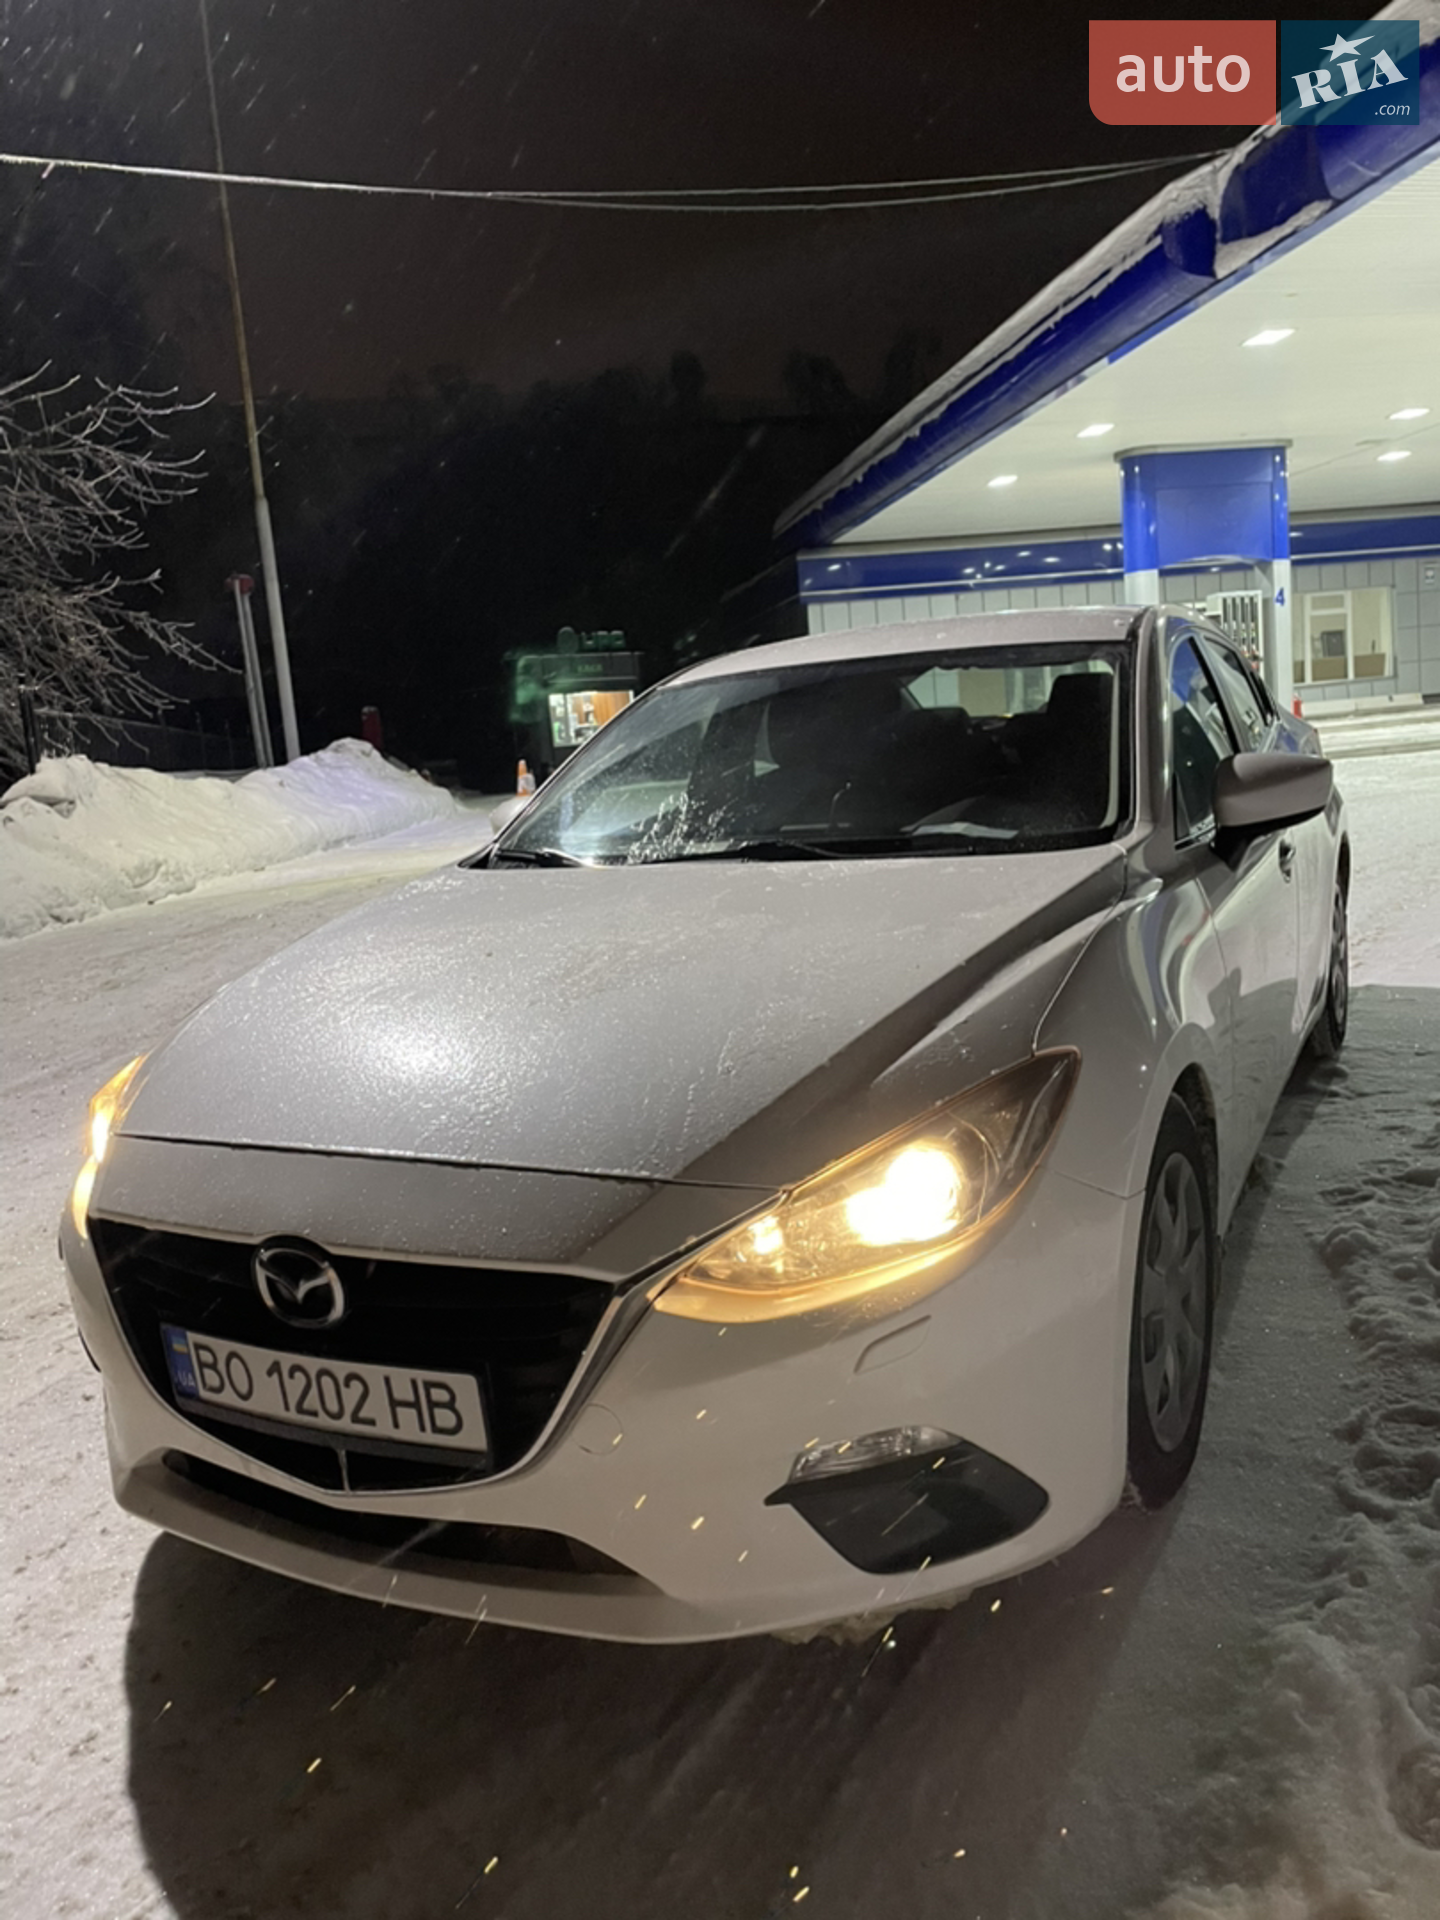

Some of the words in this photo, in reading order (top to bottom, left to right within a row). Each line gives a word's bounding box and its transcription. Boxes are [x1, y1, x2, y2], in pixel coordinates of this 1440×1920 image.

[1274, 588, 1285, 606] 4
[193, 1343, 253, 1401] BO
[266, 1360, 377, 1427] 1202
[383, 1375, 464, 1436] HB
